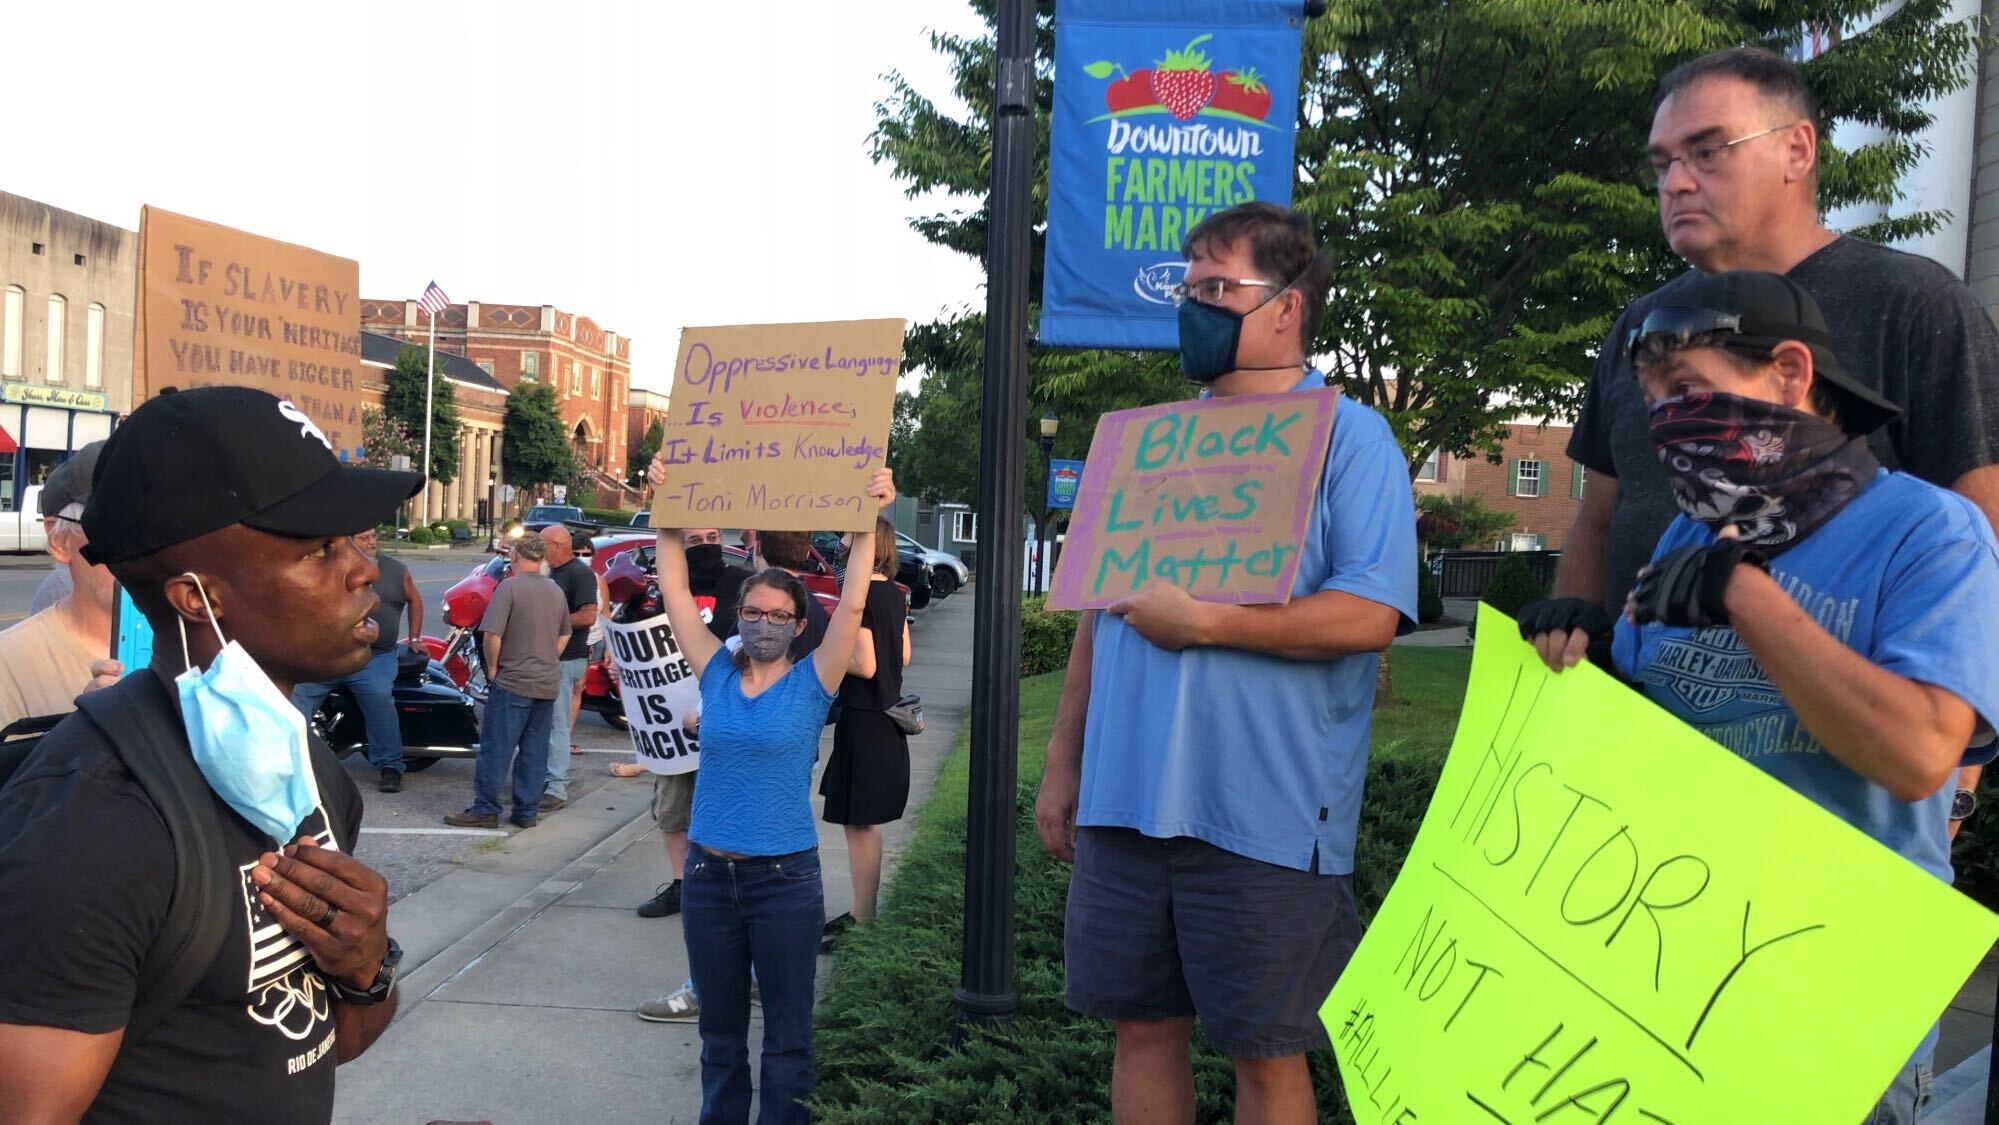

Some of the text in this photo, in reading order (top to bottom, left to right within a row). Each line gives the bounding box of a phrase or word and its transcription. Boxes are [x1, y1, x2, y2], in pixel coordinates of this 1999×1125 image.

[1107, 119, 1264, 157] Downtown
[1106, 156, 1256, 205] FARMERS
[1104, 204, 1225, 251] MARK
[174, 244, 349, 315] IF SLAVERY
[181, 298, 209, 332] IS
[215, 304, 273, 340] YOUR
[169, 338, 222, 373] YOU
[229, 350, 281, 378] HAVE
[288, 359, 355, 392] BIGGER
[684, 343, 899, 394] Oppressive Language
[301, 394, 344, 423] THAN
[663, 432, 884, 470] It Limits Knowledge
[1134, 411, 1304, 471] Black
[747, 484, 863, 513] Morrison
[1105, 479, 1264, 533] Lives
[1092, 539, 1296, 595] Matter
[620, 658, 692, 689] ERITAGE
[637, 694, 673, 725] IS
[631, 725, 700, 760] RACIS
[1450, 664, 1826, 1050] HISTORY
[1394, 904, 1504, 1032] NOT
[288, 1054, 306, 1075] RIO
[306, 1047, 317, 1067] DE
